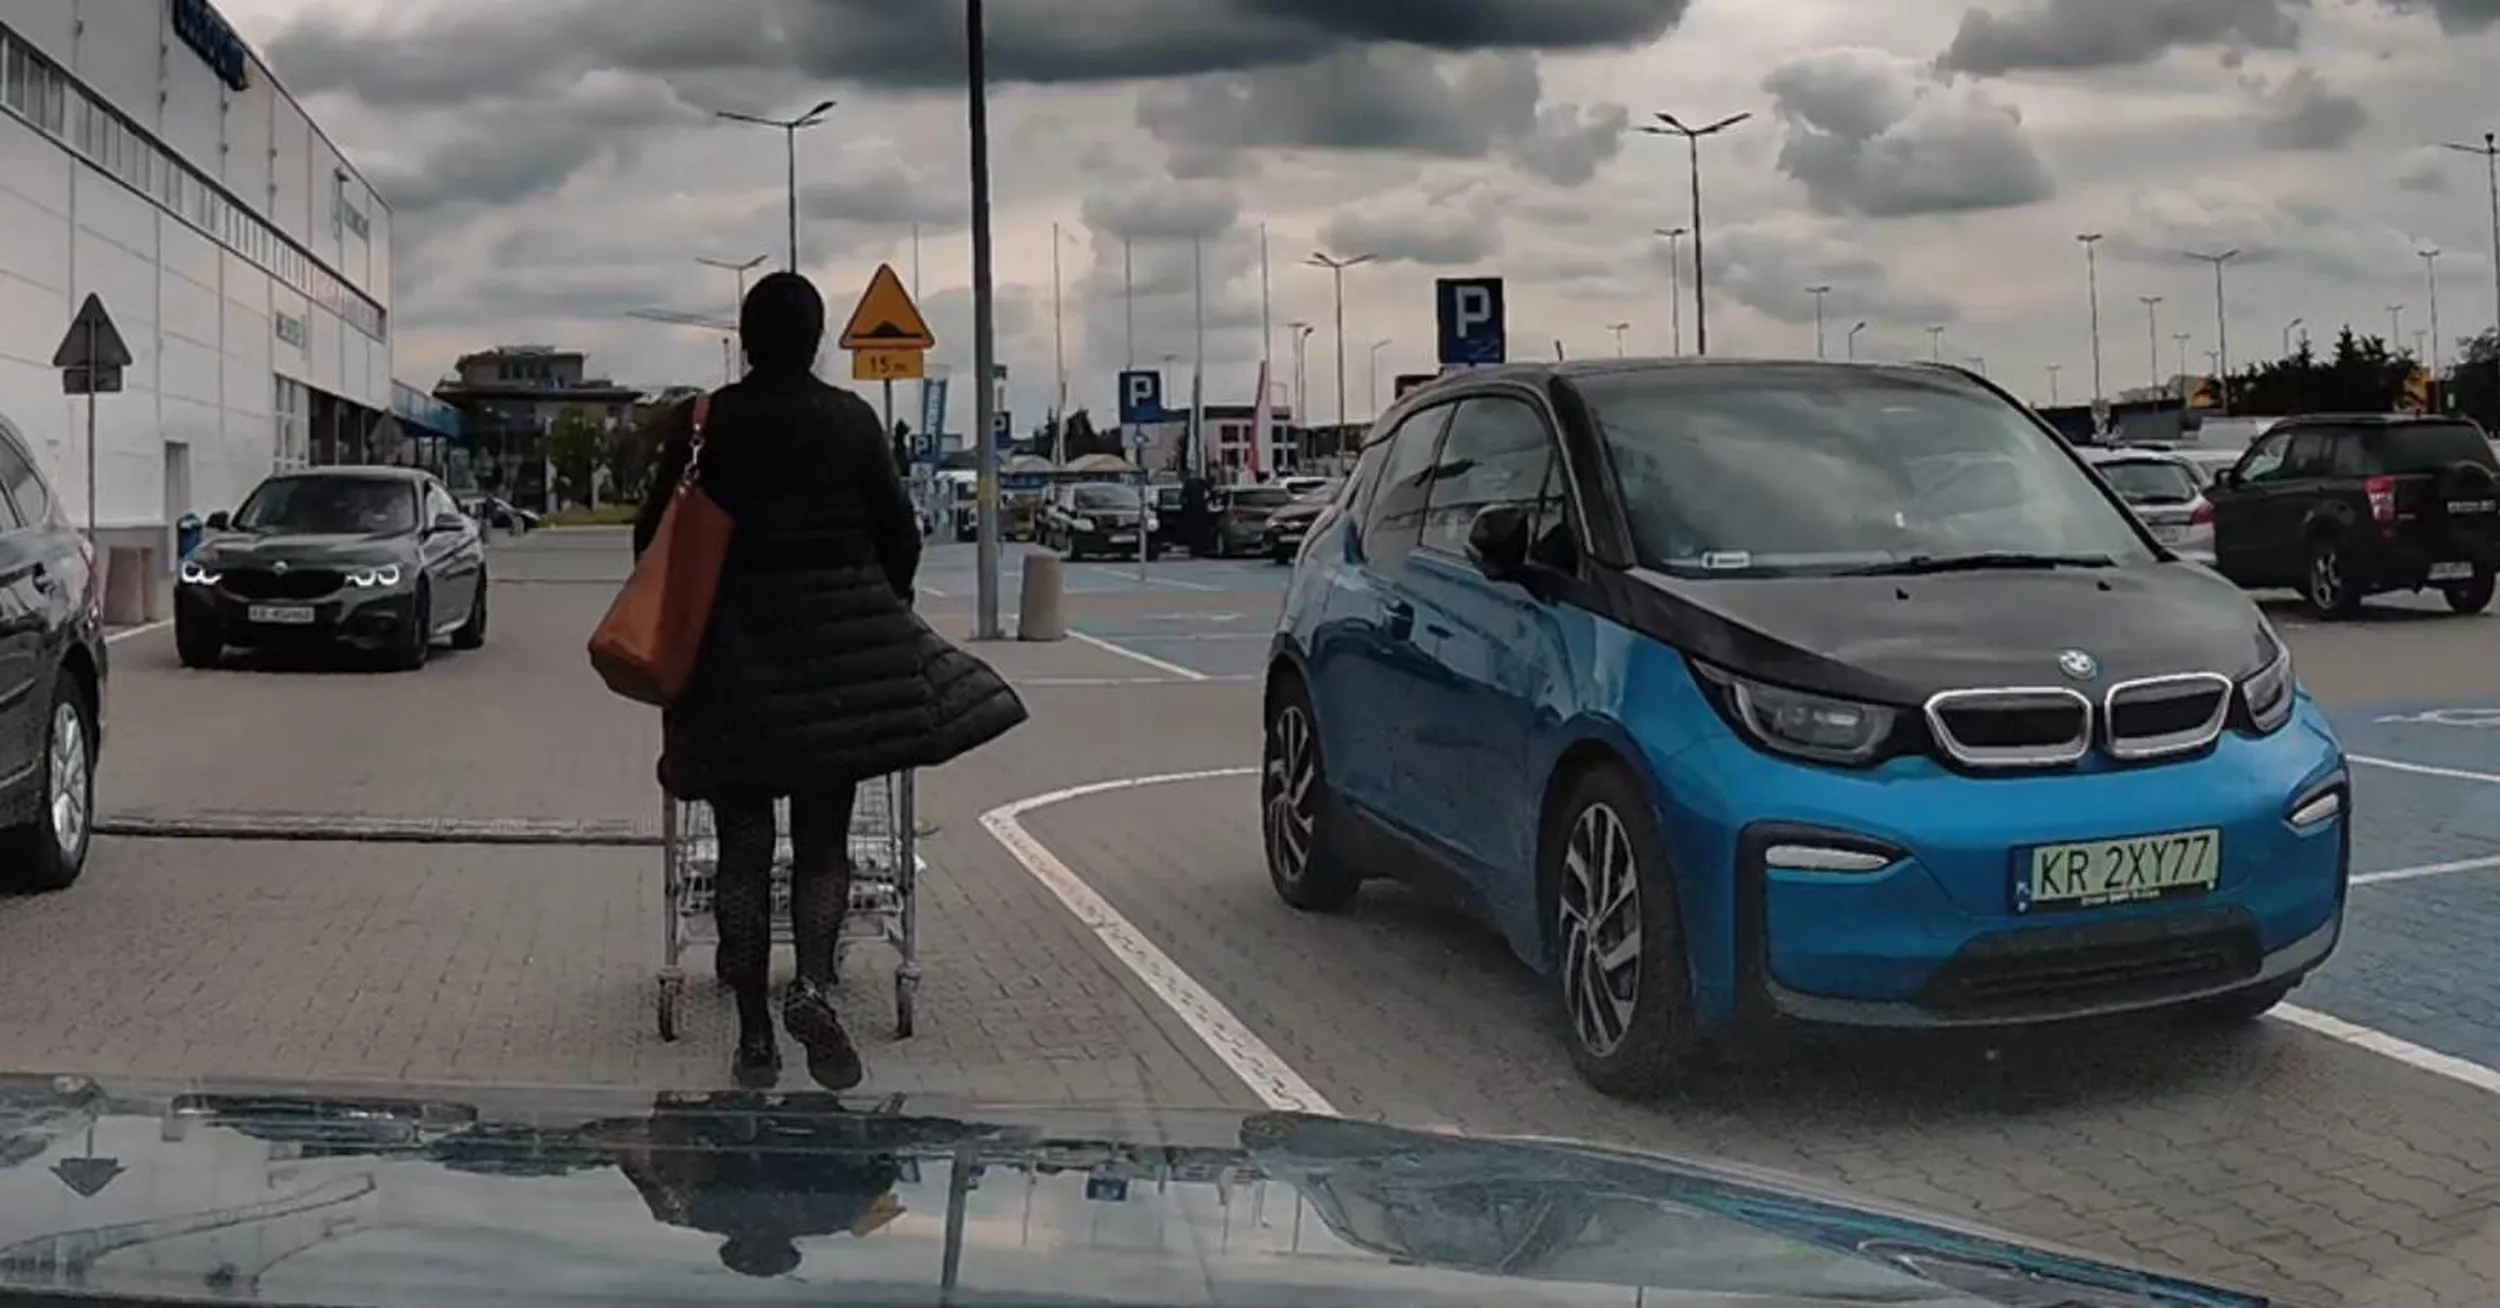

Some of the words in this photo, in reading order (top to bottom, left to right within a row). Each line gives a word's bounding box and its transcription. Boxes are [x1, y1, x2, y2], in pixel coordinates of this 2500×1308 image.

[1457, 285, 1490, 338] P
[870, 356, 890, 373] 15
[1131, 376, 1152, 407] P
[915, 437, 928, 455] P
[2041, 850, 2089, 894] KR
[2104, 834, 2210, 888] 2XY77
